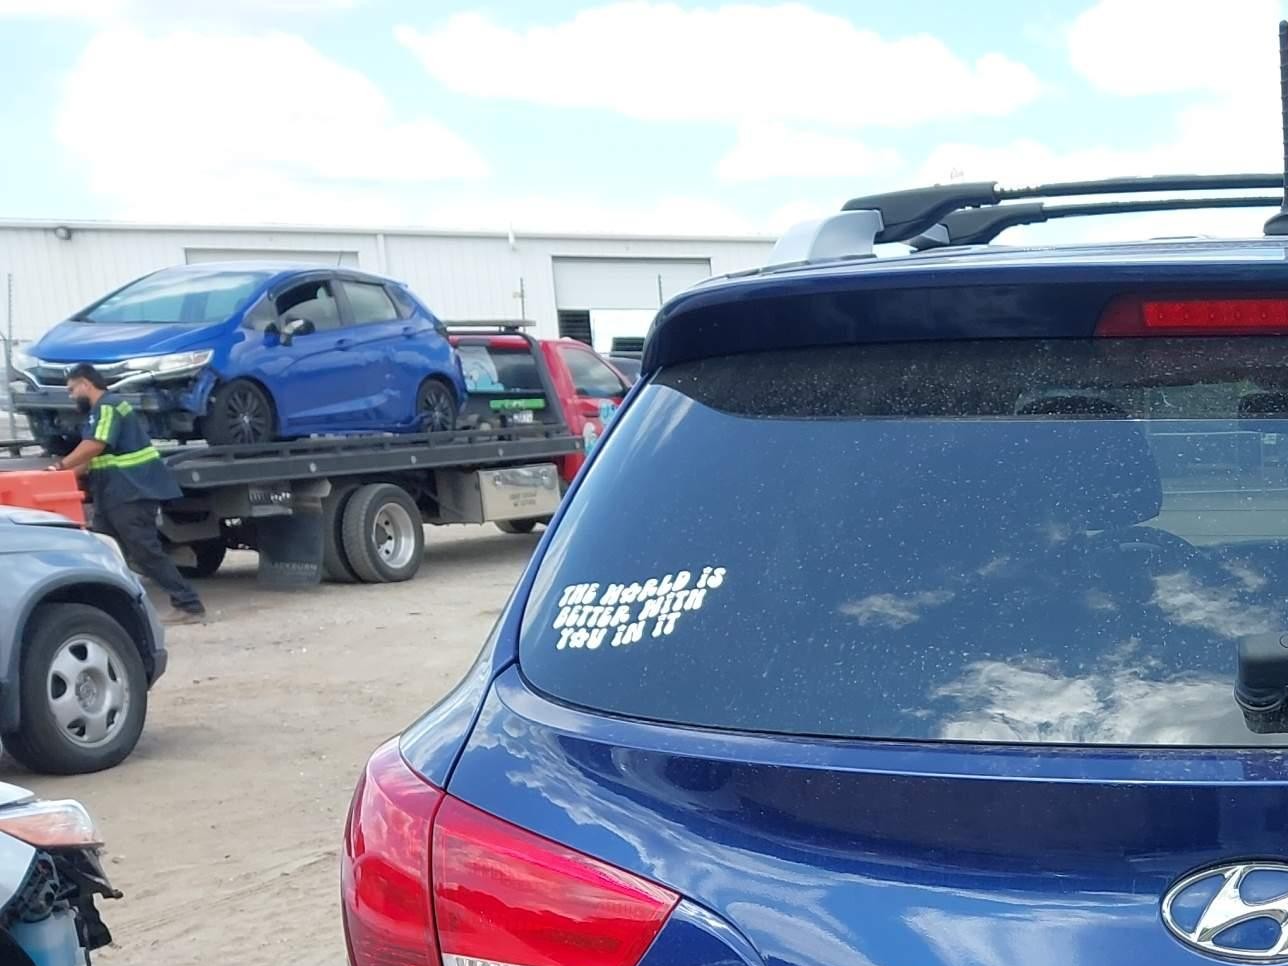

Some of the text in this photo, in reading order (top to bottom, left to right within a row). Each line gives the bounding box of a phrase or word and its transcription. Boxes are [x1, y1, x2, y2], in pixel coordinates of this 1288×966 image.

[558, 583, 600, 607] THE
[600, 571, 691, 606] WORLD
[553, 605, 631, 629] BETTER
[556, 627, 608, 650] YOU
